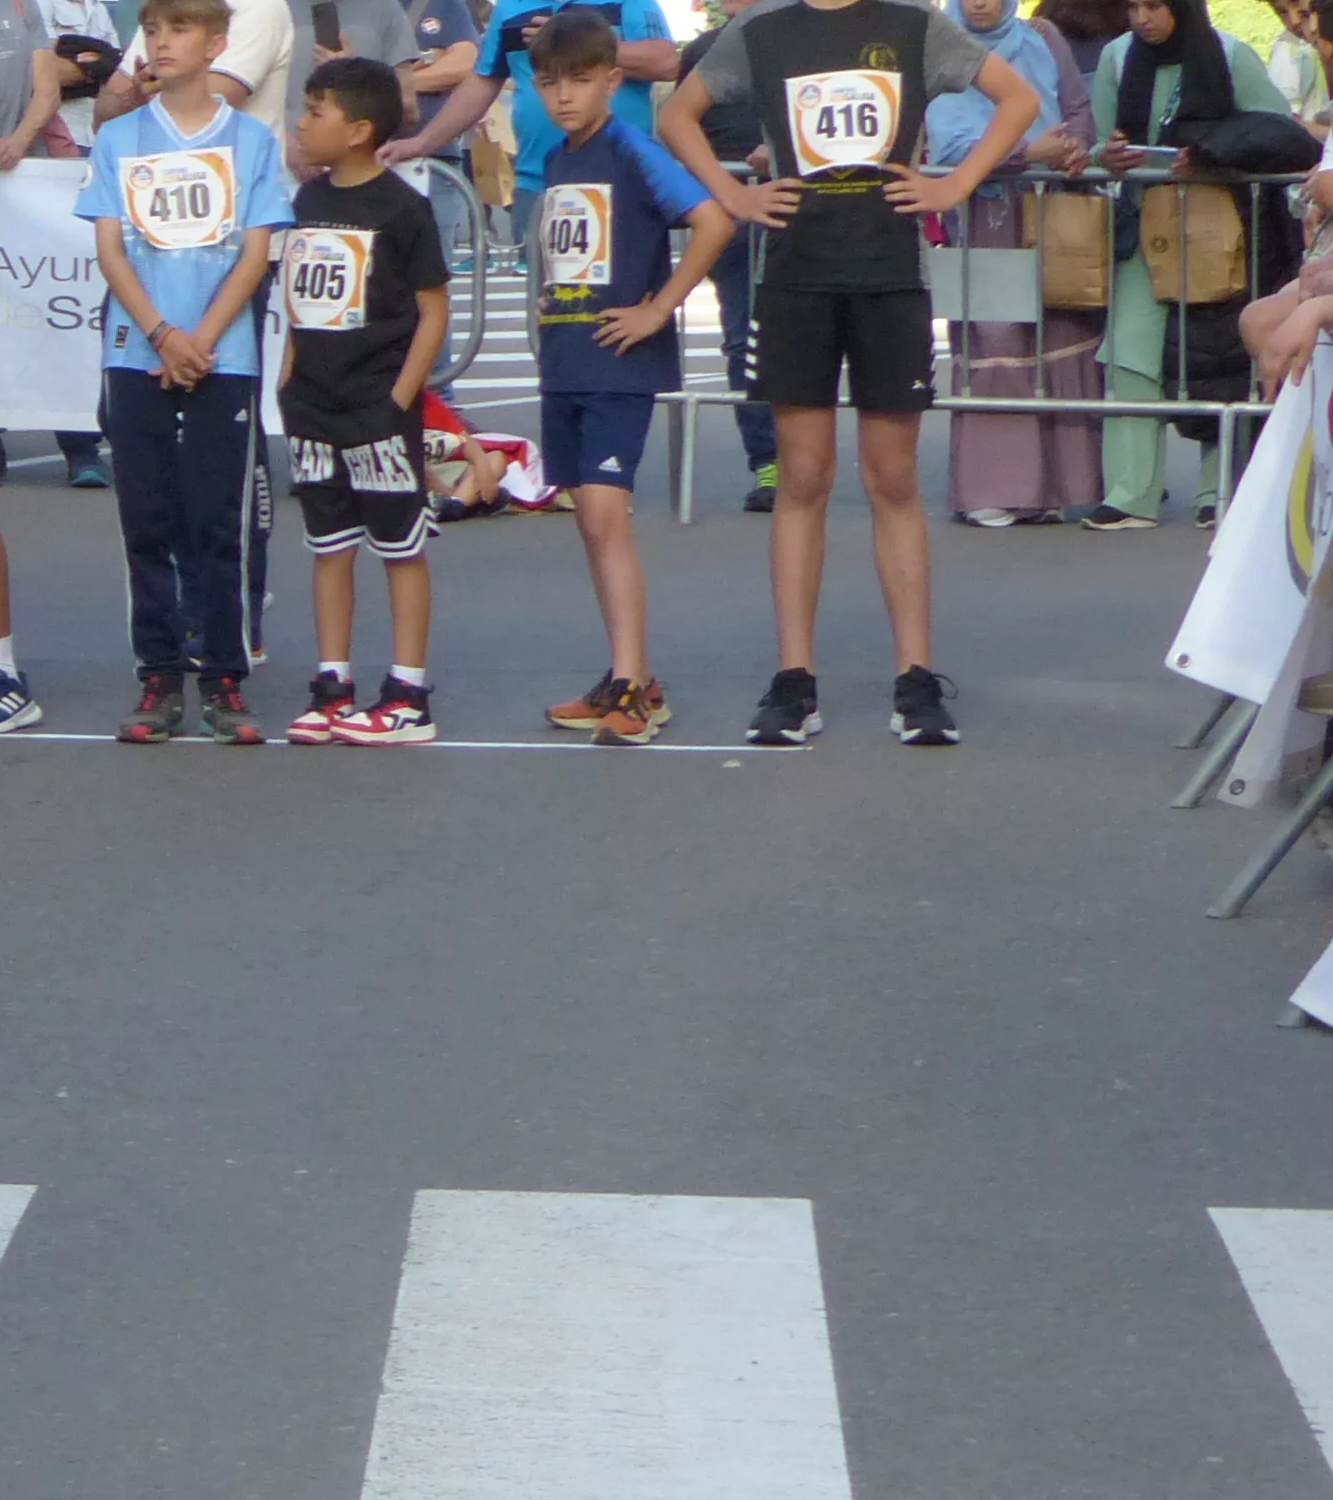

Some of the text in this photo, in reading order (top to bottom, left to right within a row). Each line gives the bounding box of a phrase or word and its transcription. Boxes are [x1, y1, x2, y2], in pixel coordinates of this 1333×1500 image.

[816, 103, 879, 139] 416
[149, 182, 211, 222] 410
[293, 263, 346, 301] 405
